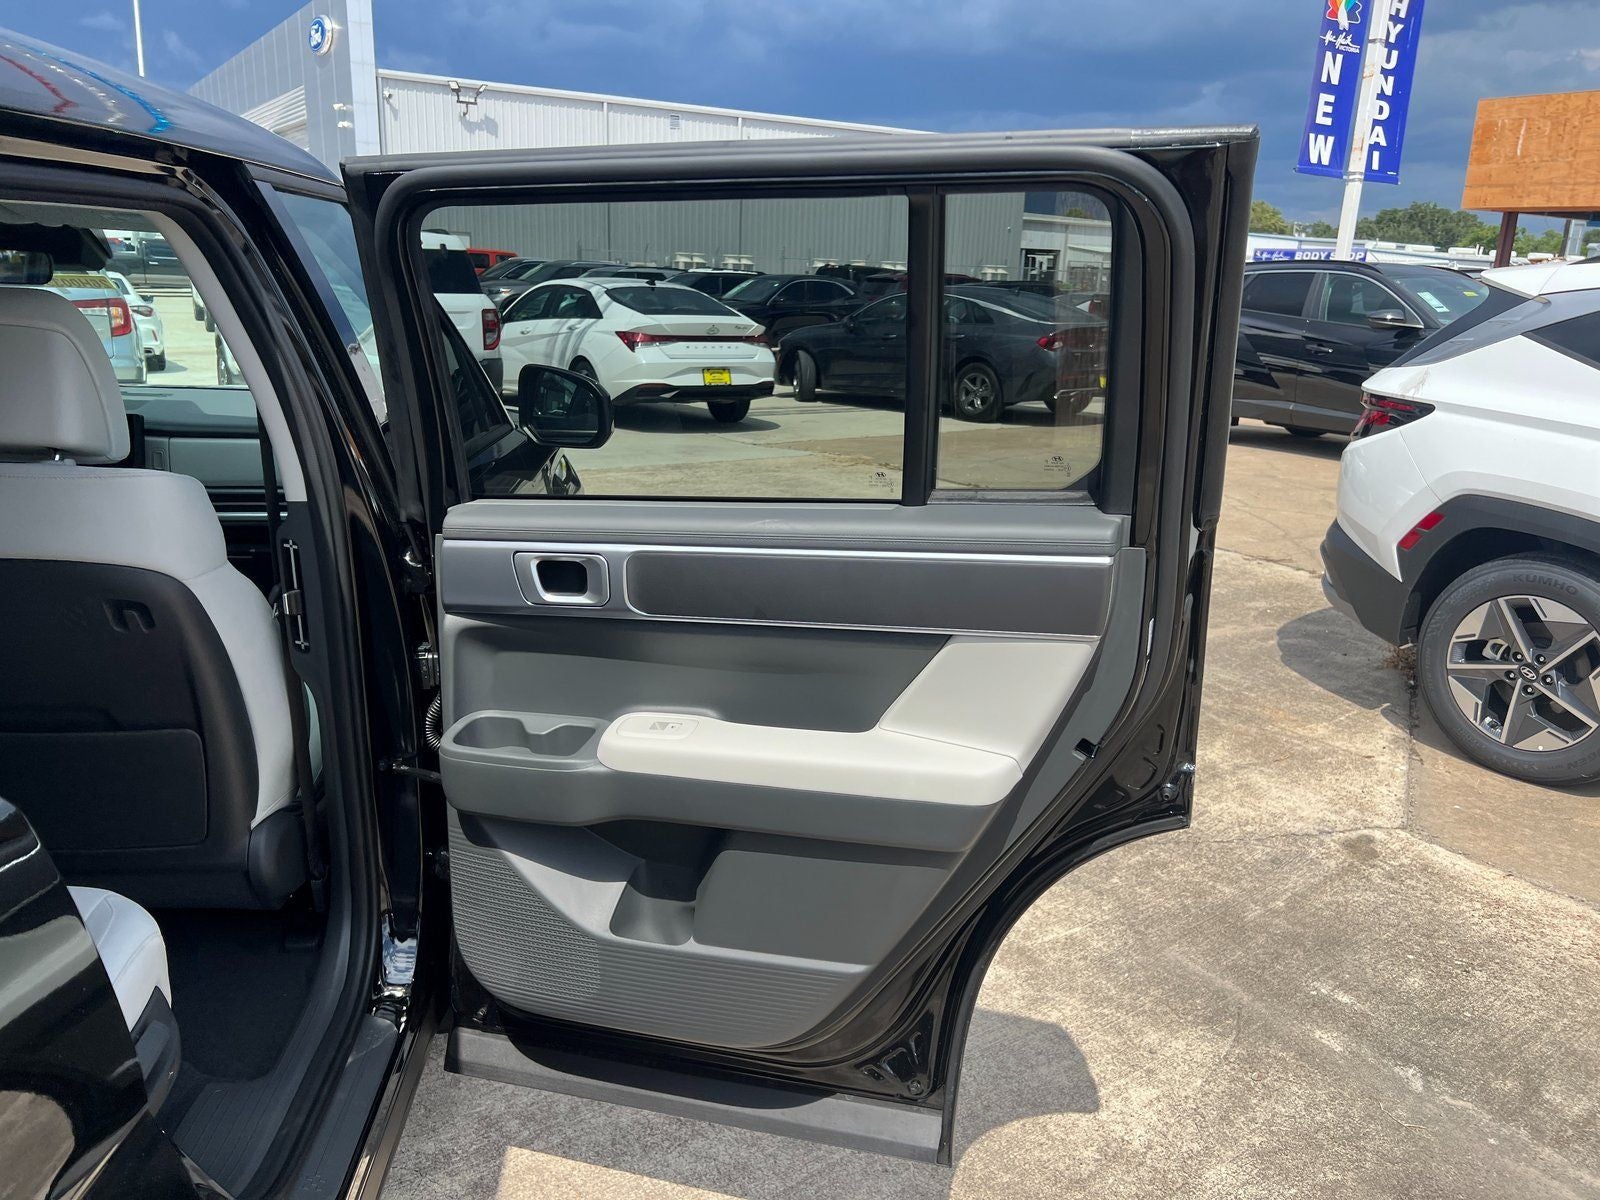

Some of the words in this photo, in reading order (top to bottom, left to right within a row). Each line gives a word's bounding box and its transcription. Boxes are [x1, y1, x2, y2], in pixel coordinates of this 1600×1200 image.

[1308, 51, 1343, 166] NEW
[1368, 0, 1409, 171] HYUNDAI
[1294, 251, 1328, 261] BODY
[1329, 251, 1365, 261] SOP
[1512, 573, 1579, 596] KUMHO
